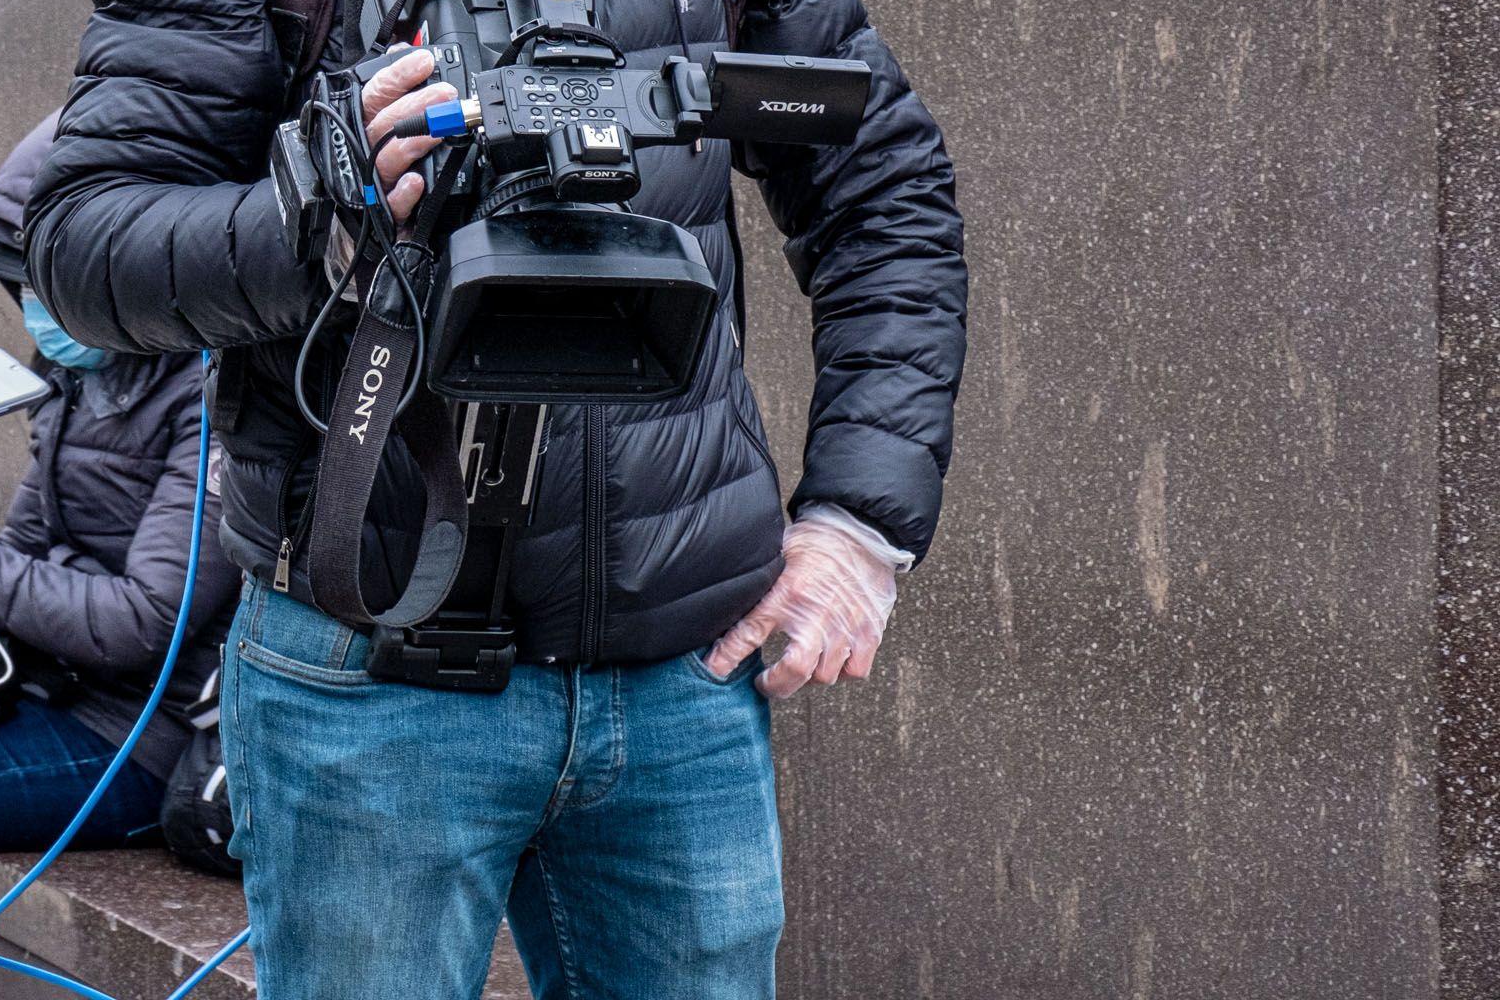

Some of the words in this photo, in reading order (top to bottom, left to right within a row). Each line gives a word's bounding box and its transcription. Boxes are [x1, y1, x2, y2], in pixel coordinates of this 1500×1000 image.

[758, 100, 826, 114] XDCAM
[584, 170, 619, 178] SONY
[349, 345, 391, 445] SONY
